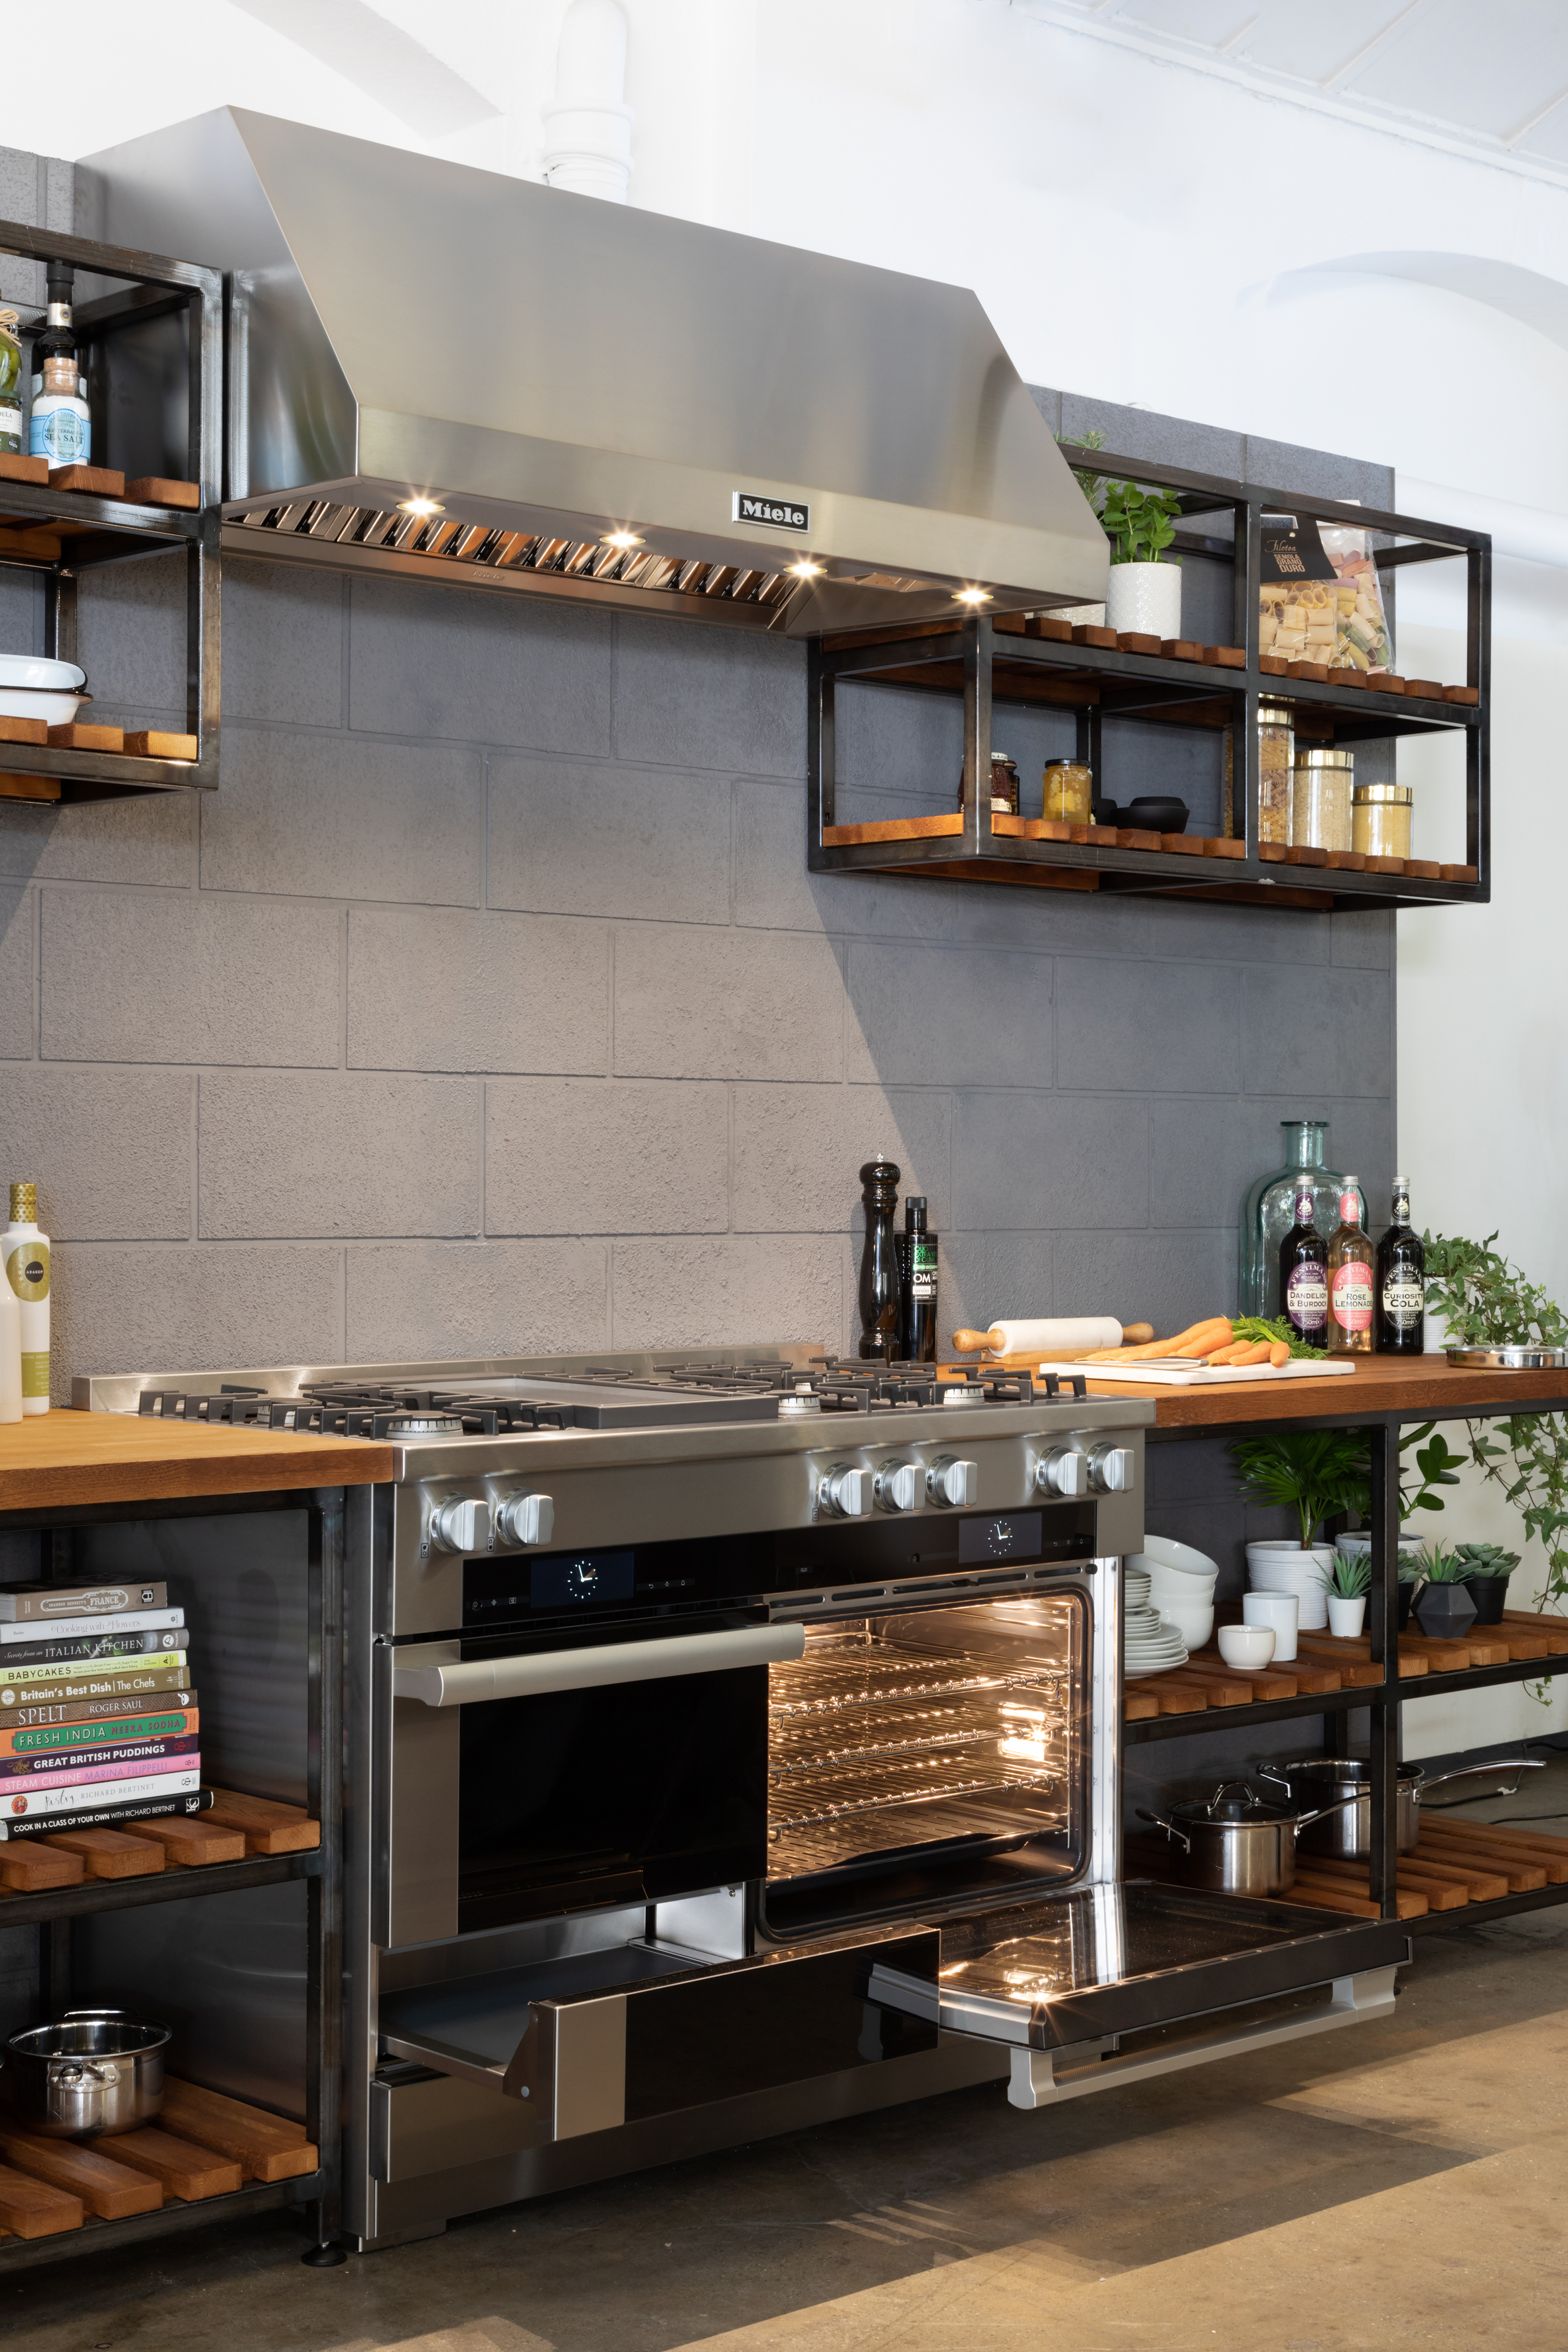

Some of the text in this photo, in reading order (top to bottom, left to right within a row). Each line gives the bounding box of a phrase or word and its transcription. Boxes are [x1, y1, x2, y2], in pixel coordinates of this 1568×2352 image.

[64, 435, 84, 444] SALT
[743, 500, 805, 524] Miele
[1265, 540, 1296, 553] Filotea
[913, 1273, 931, 1283] OM
[1291, 1265, 1327, 1283] FENTIMANS
[1338, 1267, 1372, 1284] FENTIMANS
[1386, 1265, 1423, 1284] FENTIMANS
[1390, 1299, 1419, 1308] COLA
[90, 1595, 119, 1606] FRANCE
[51, 1620, 141, 1634] Cooking with Flowers
[22, 1650, 35, 1658] from
[45, 1644, 91, 1658] ITALIAN
[95, 1639, 143, 1652] KITCHEN
[8, 1667, 72, 1680] BABYCAKES
[21, 1677, 155, 1701] Britain's Best Dish The Chefs
[19, 1700, 143, 1725] SPELT ROGER SAUL
[19, 1719, 180, 1747] FRESH INDIA MEERA SODHA
[34, 1745, 165, 1769] GREAT BRITISH PUDDINGS
[5, 1762, 167, 1791] STEAM CUISINE MARINA FILIPPELLI
[80, 1788, 116, 1799] RICHARD
[118, 1783, 155, 1794] BERTINET
[13, 1824, 34, 1832] COOK
[48, 1819, 67, 1828] CLASS
[76, 1815, 94, 1824] YOUR
[94, 1813, 110, 1822] OWN
[125, 1808, 151, 1817] RICHARD
[151, 1804, 176, 1814] BERTINET
